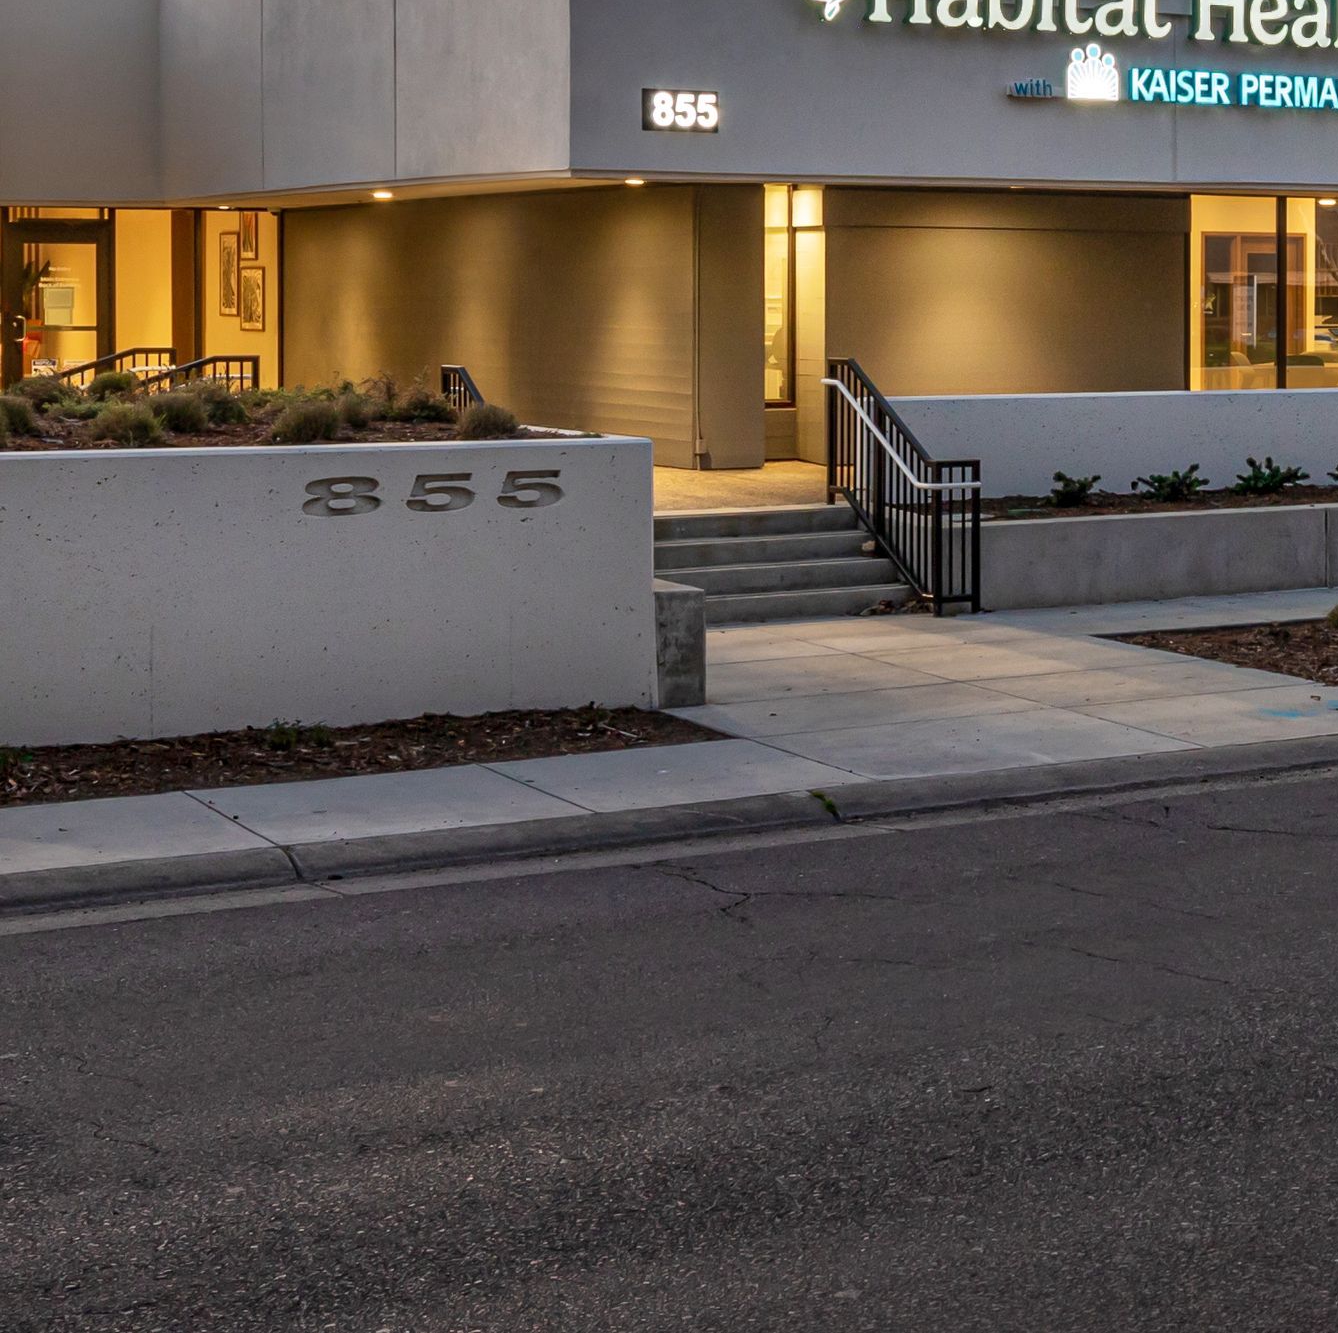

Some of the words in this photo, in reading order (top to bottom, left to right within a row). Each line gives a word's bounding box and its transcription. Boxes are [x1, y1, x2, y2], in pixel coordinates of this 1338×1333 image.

[1012, 78, 1053, 96] with
[1130, 68, 1230, 105] KAISER
[653, 92, 718, 128] 855
[302, 469, 564, 516] 855
